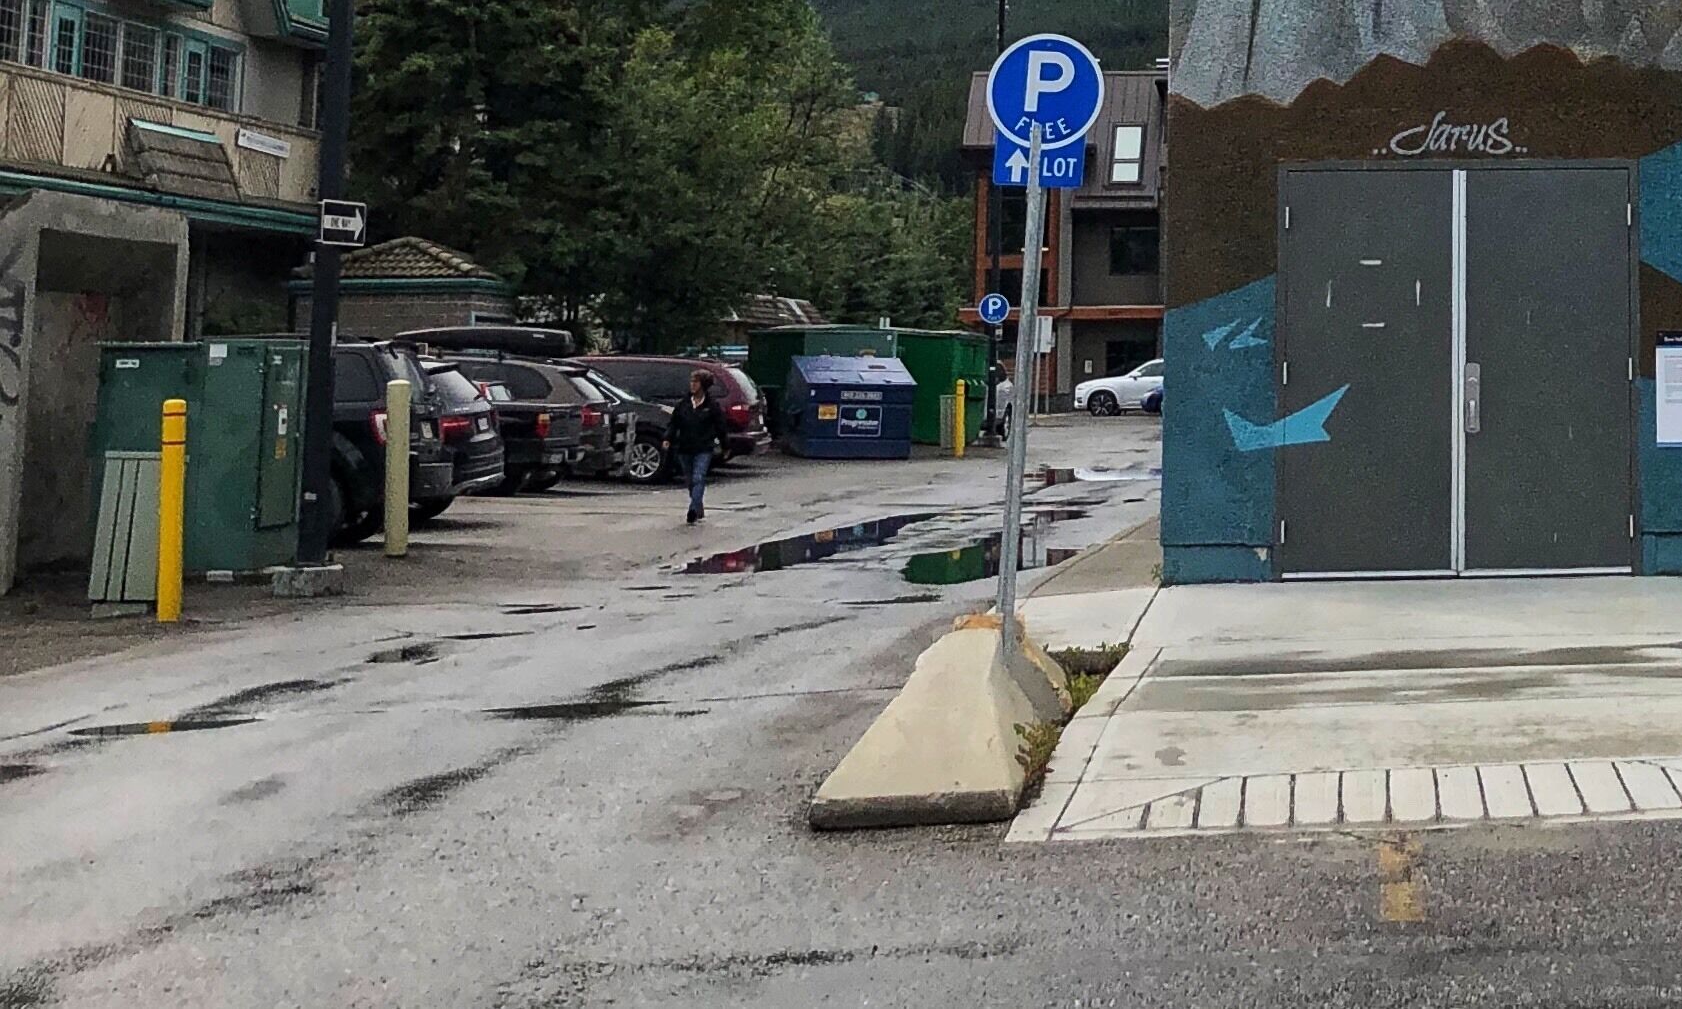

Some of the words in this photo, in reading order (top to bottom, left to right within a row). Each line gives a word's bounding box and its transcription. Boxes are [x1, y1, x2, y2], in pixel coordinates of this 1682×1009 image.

[1024, 50, 1075, 112] P
[1014, 116, 1071, 139] FEE
[1042, 157, 1077, 178] LOT
[988, 298, 1001, 315] P
